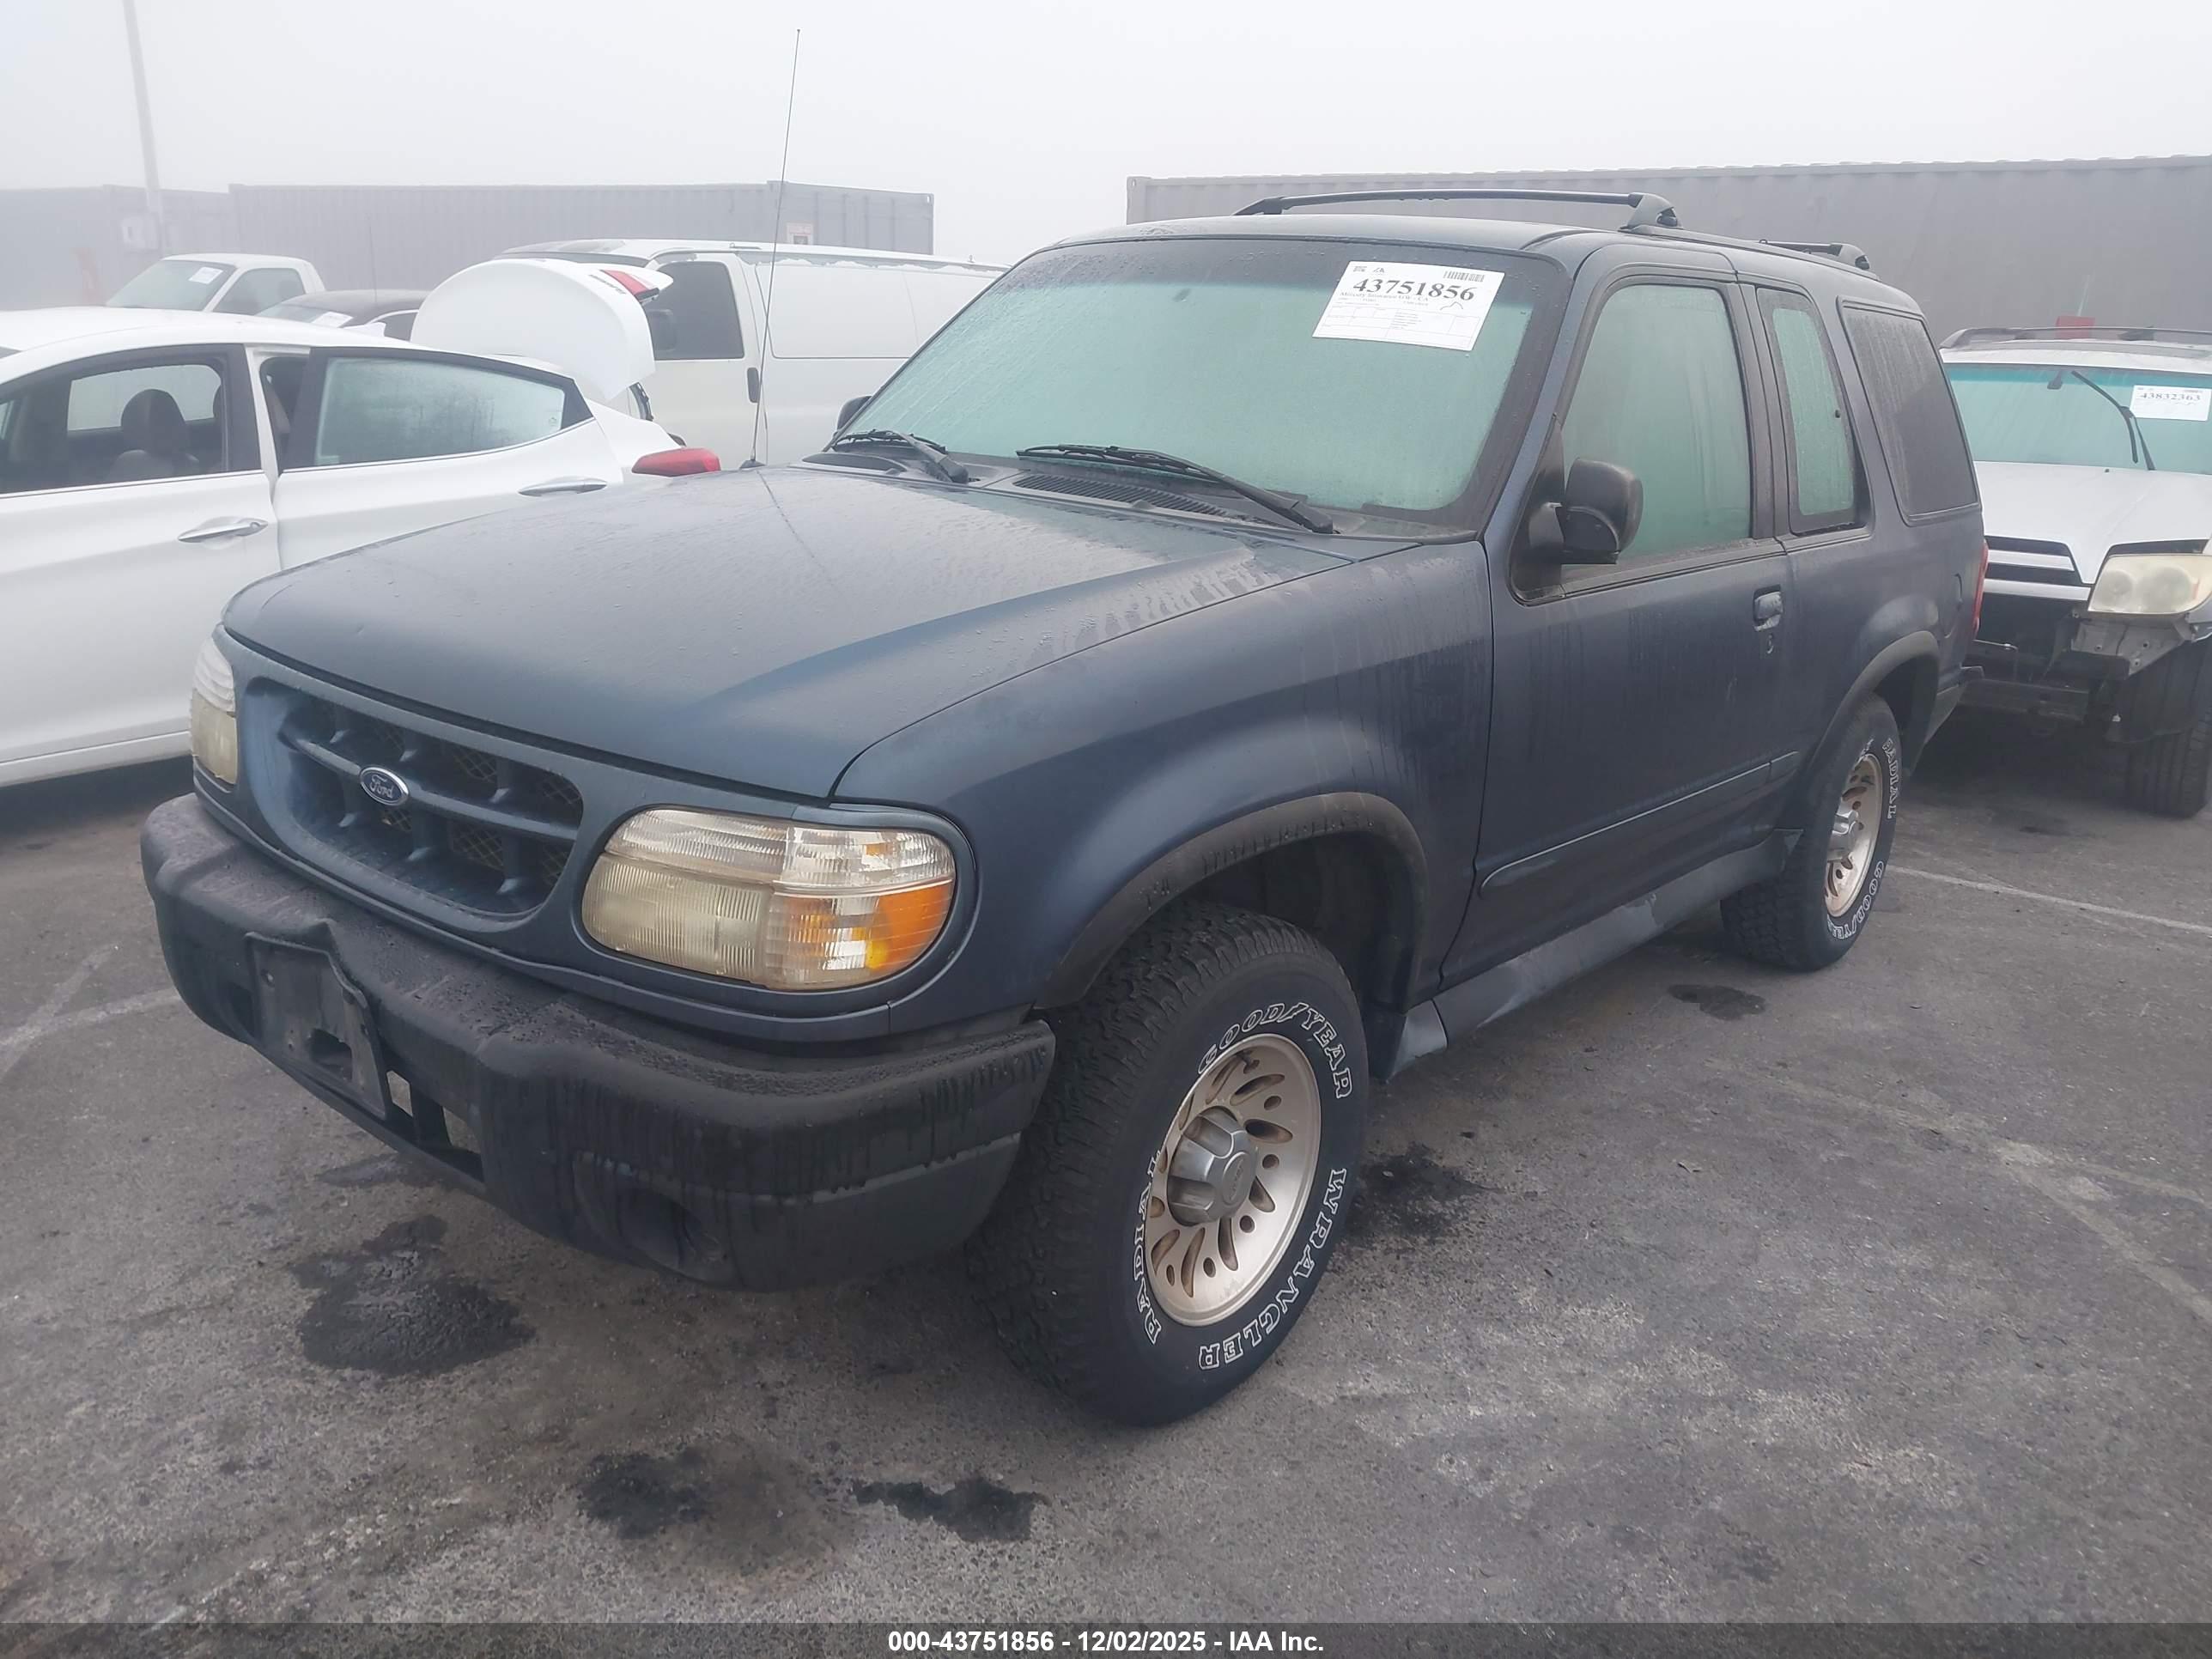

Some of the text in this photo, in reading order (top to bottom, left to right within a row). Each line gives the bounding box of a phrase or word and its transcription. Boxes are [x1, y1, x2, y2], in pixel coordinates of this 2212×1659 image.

[1352, 278, 1478, 301] 43751856
[369, 775, 394, 799] Ford
[1198, 1002, 1354, 1099] GOODYEAR
[1198, 1167, 1349, 1371] WRANGLER
